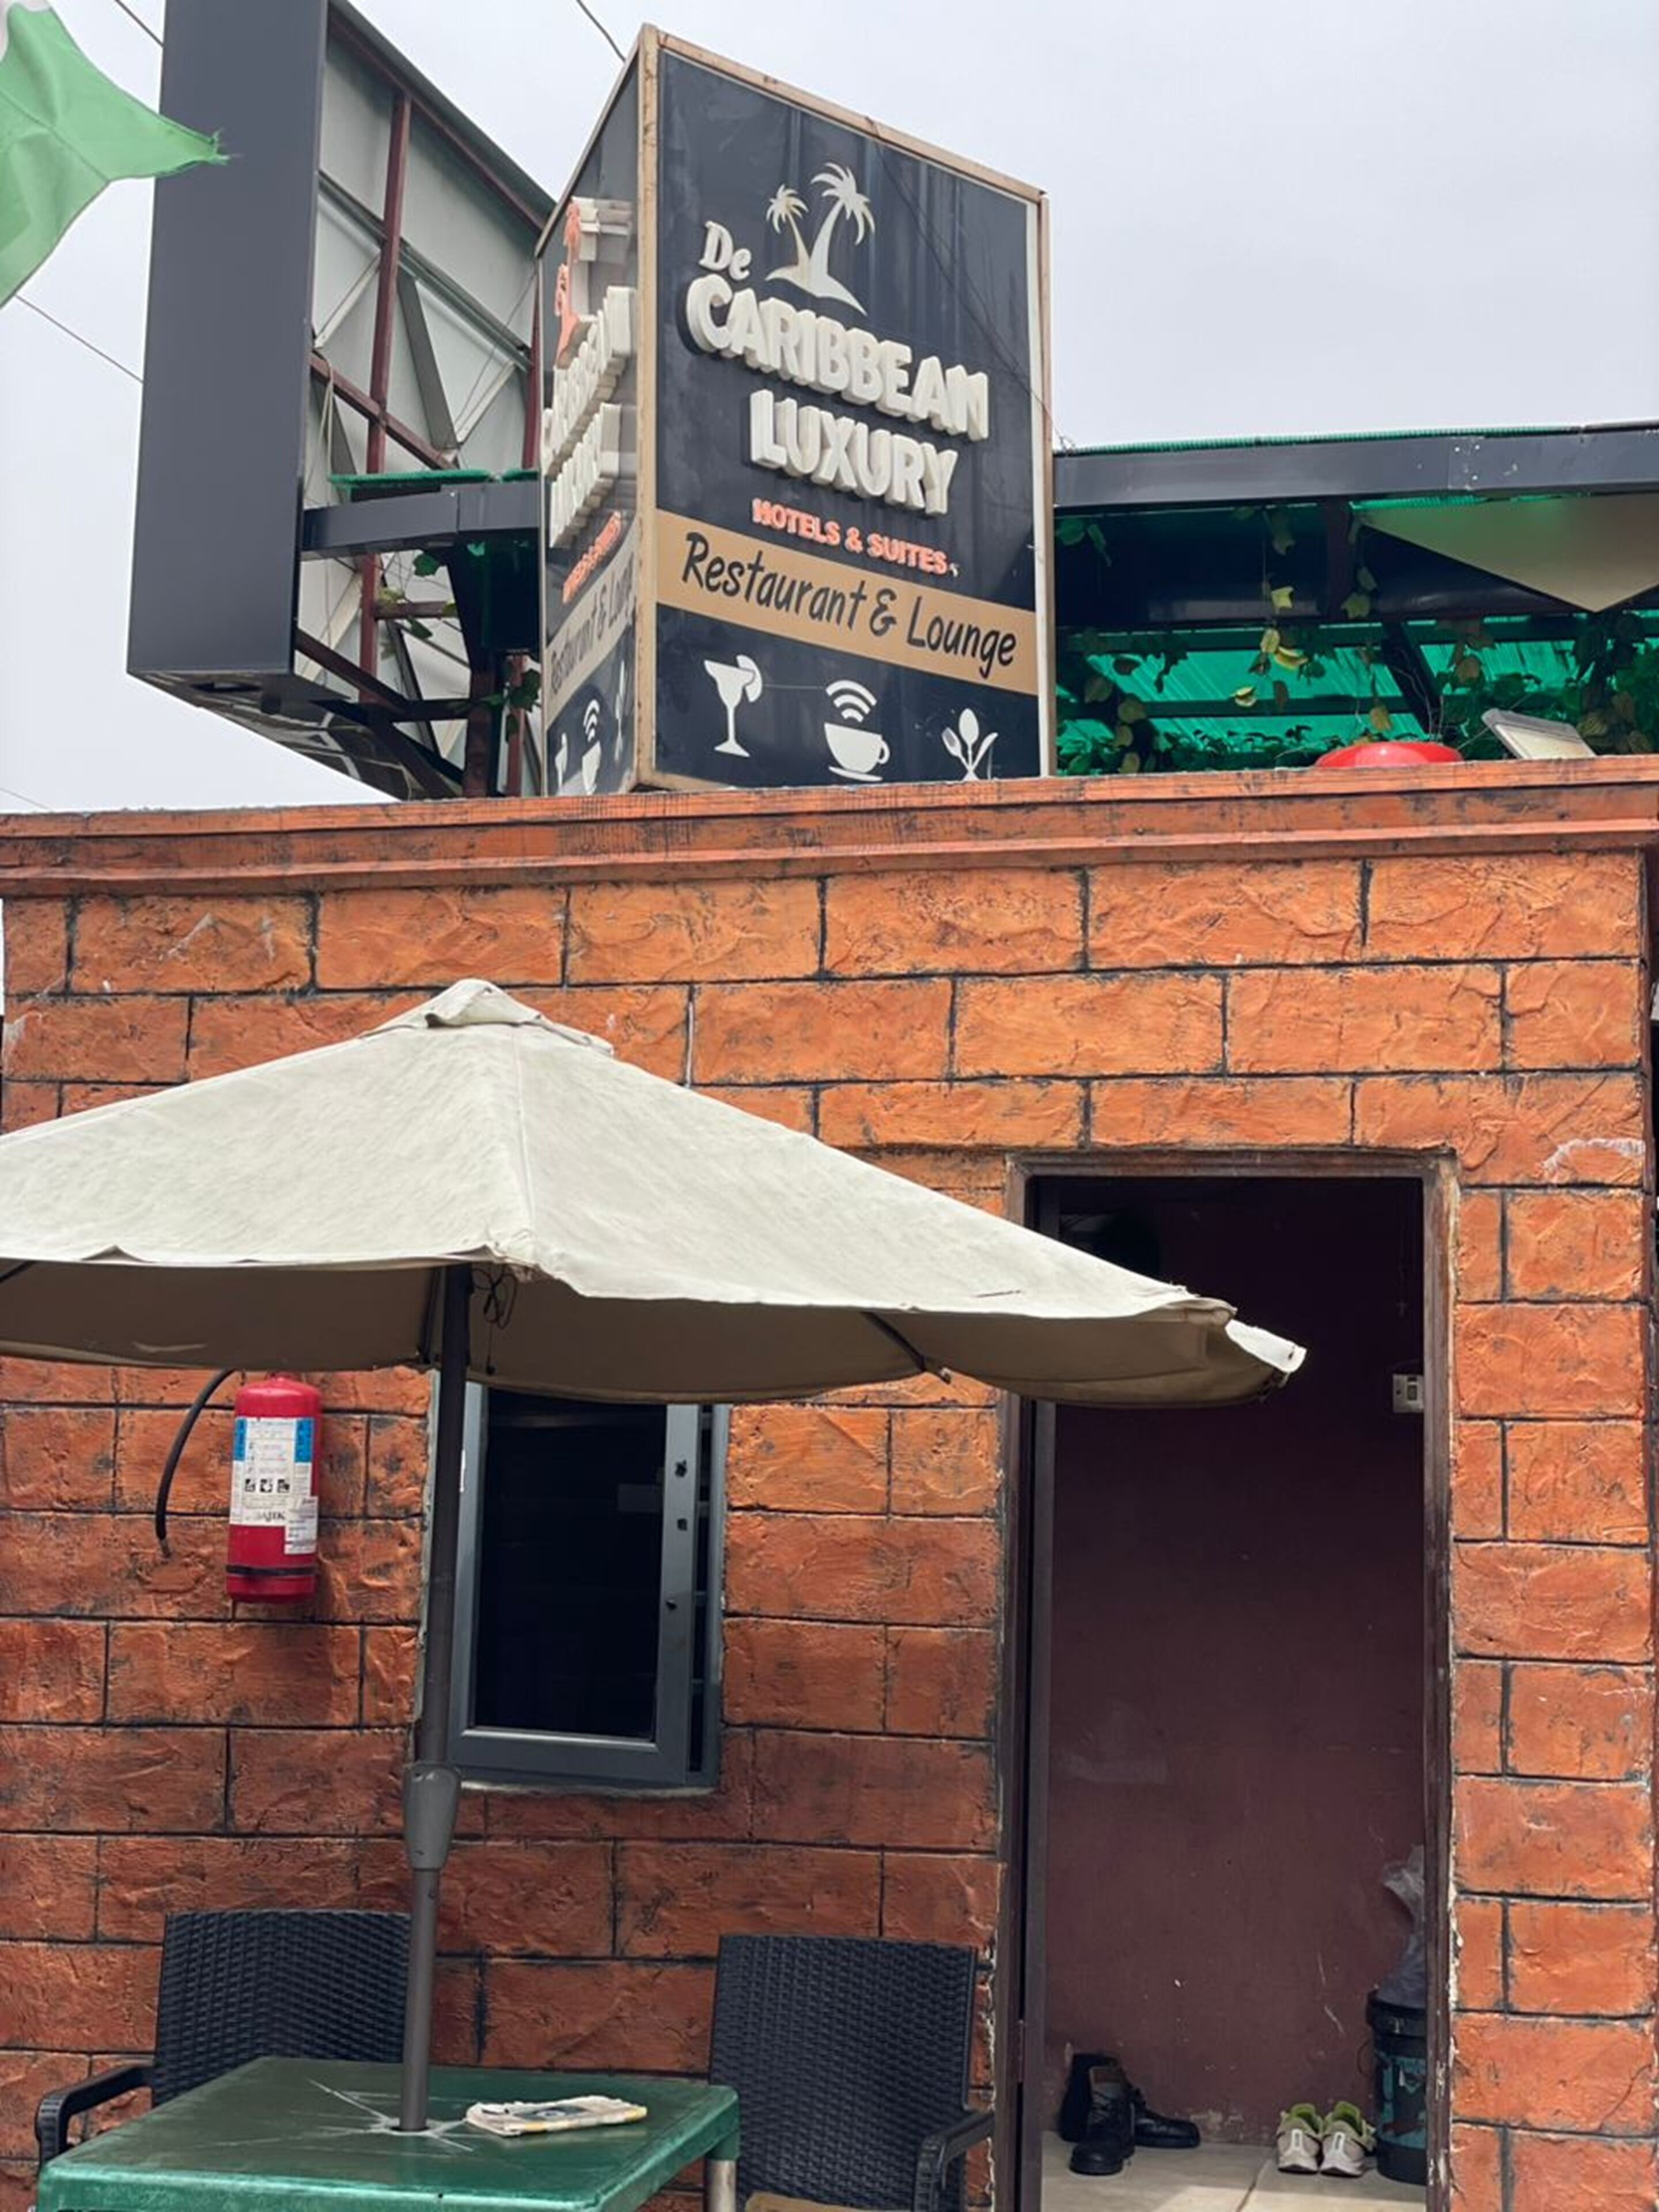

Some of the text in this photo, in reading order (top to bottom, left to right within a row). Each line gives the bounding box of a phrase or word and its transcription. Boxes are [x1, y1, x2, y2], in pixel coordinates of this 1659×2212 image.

[699, 220, 752, 281] De
[685, 274, 989, 441] CARIBBEAN
[750, 389, 959, 514] LUXURY
[752, 498, 948, 575] HOTELS & SUITES
[681, 531, 868, 631] Restaurant
[869, 588, 897, 637] &
[907, 596, 1017, 679] Lounge
